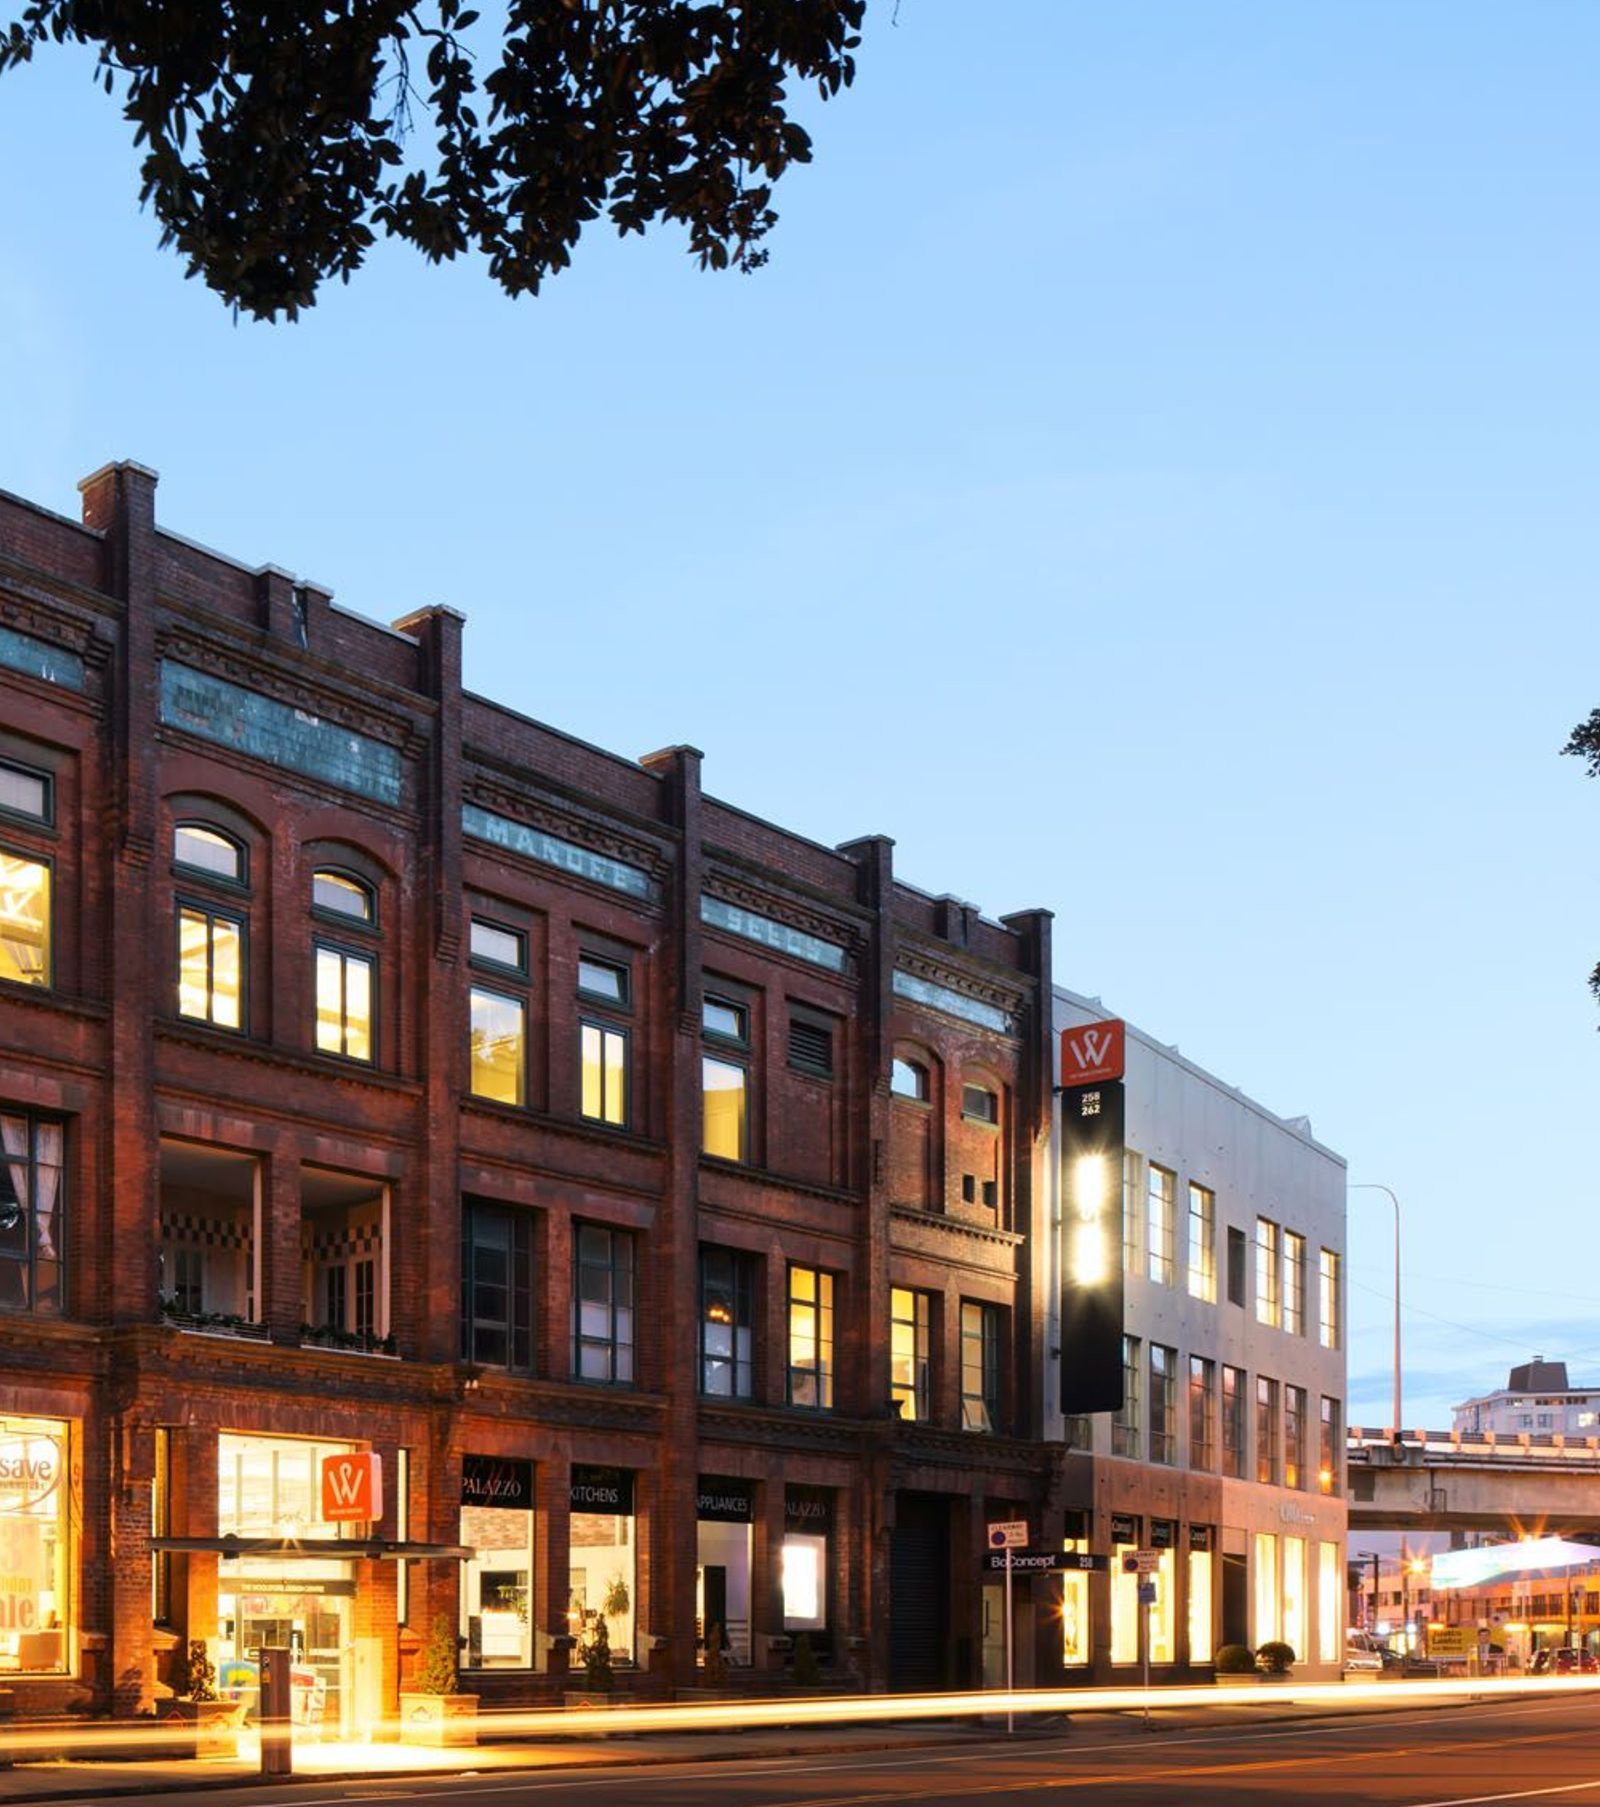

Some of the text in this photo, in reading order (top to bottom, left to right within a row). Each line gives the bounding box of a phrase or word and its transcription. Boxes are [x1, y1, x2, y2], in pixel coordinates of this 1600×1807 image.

[1081, 1104, 1100, 1117] 262
[461, 1477, 521, 1498] PALAZZO
[991, 1555, 1055, 1569] BoConcept
